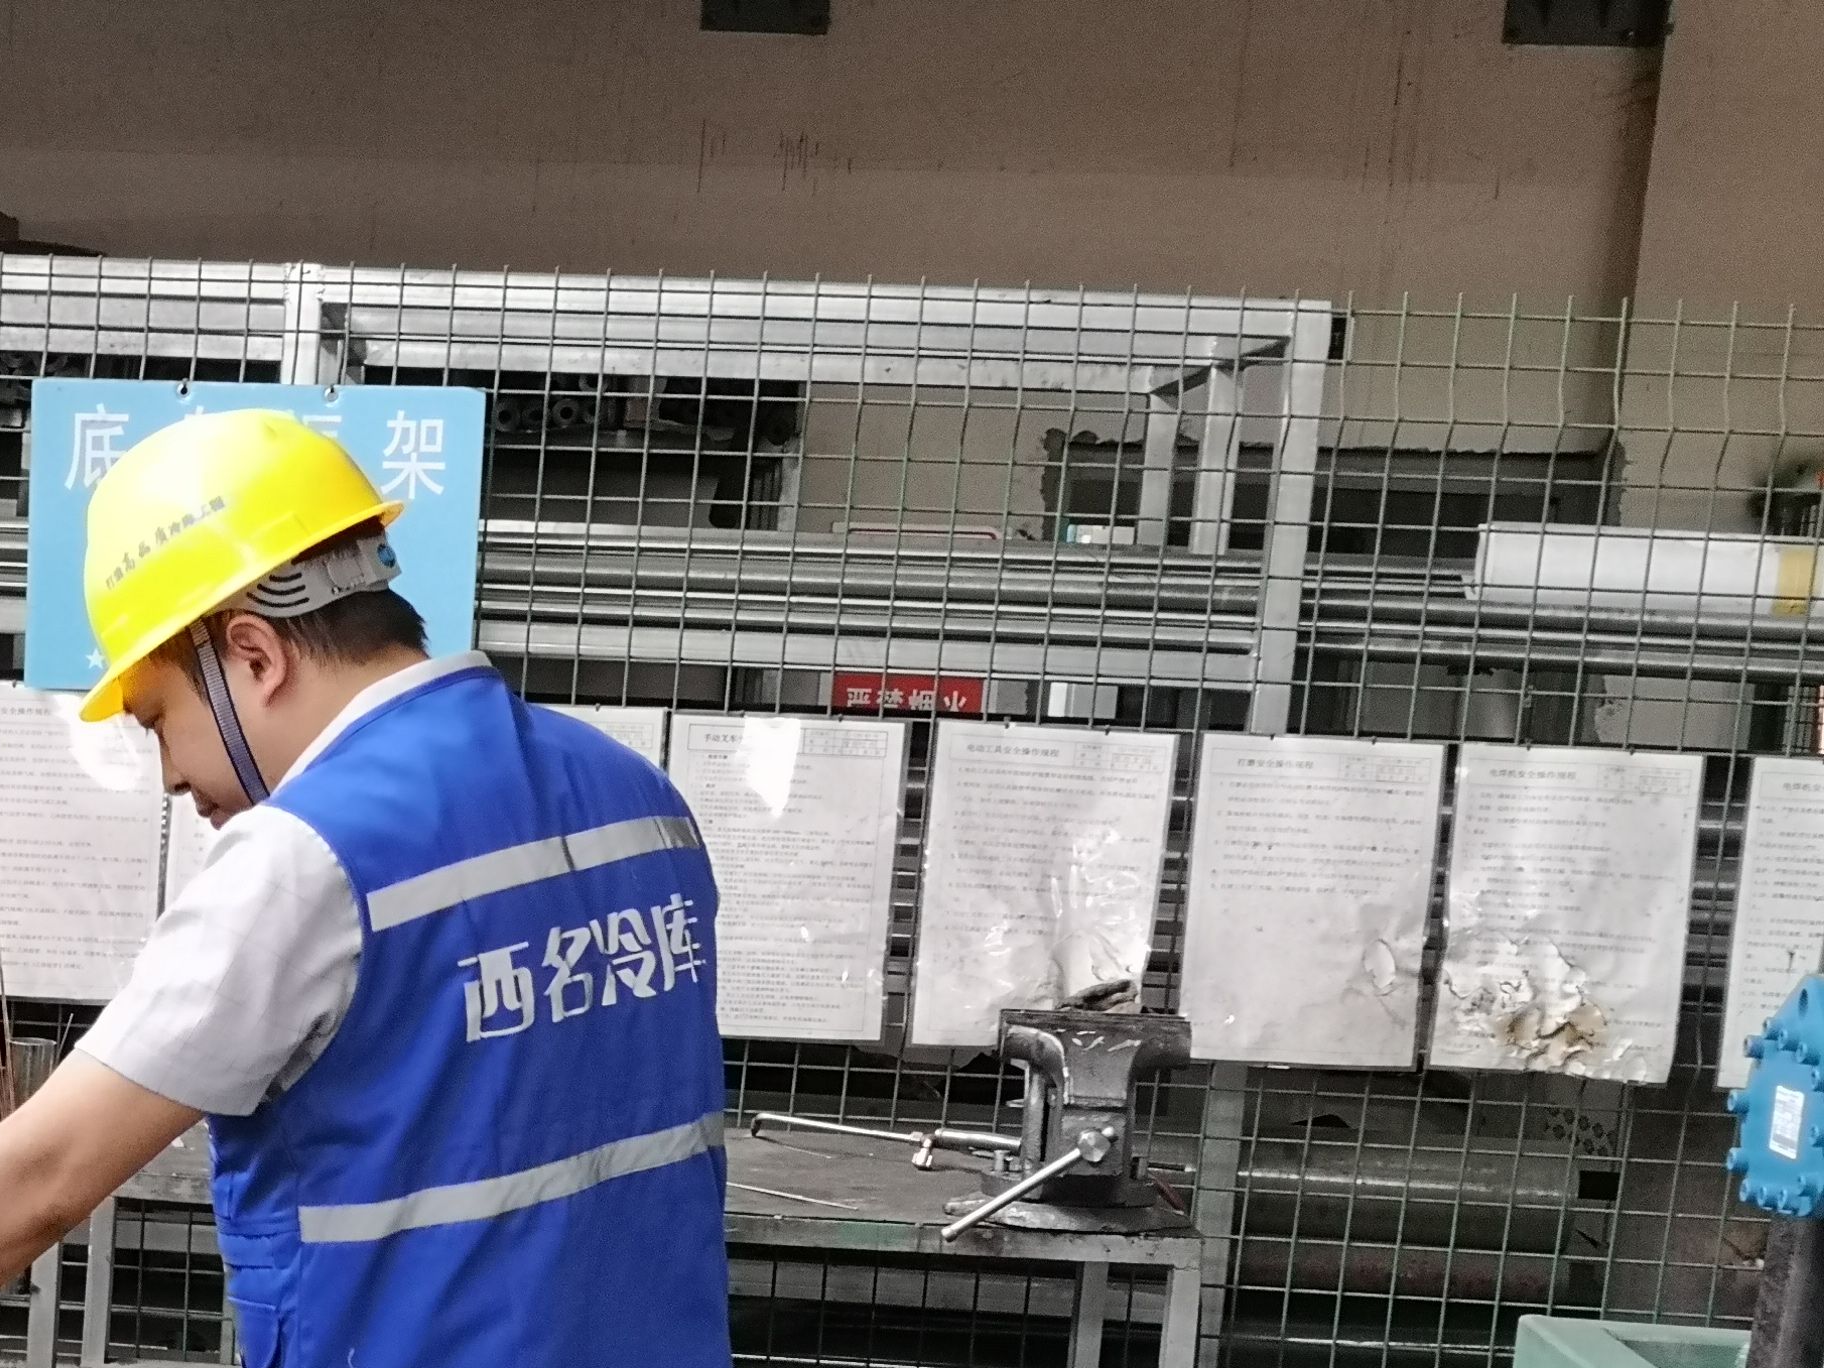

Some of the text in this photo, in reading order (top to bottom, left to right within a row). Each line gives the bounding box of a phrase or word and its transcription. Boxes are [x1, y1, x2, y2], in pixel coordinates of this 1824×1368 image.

[64, 403, 446, 499] 底架
[846, 687, 967, 713] 严禁烟火
[457, 892, 707, 1043] 西名冷库
